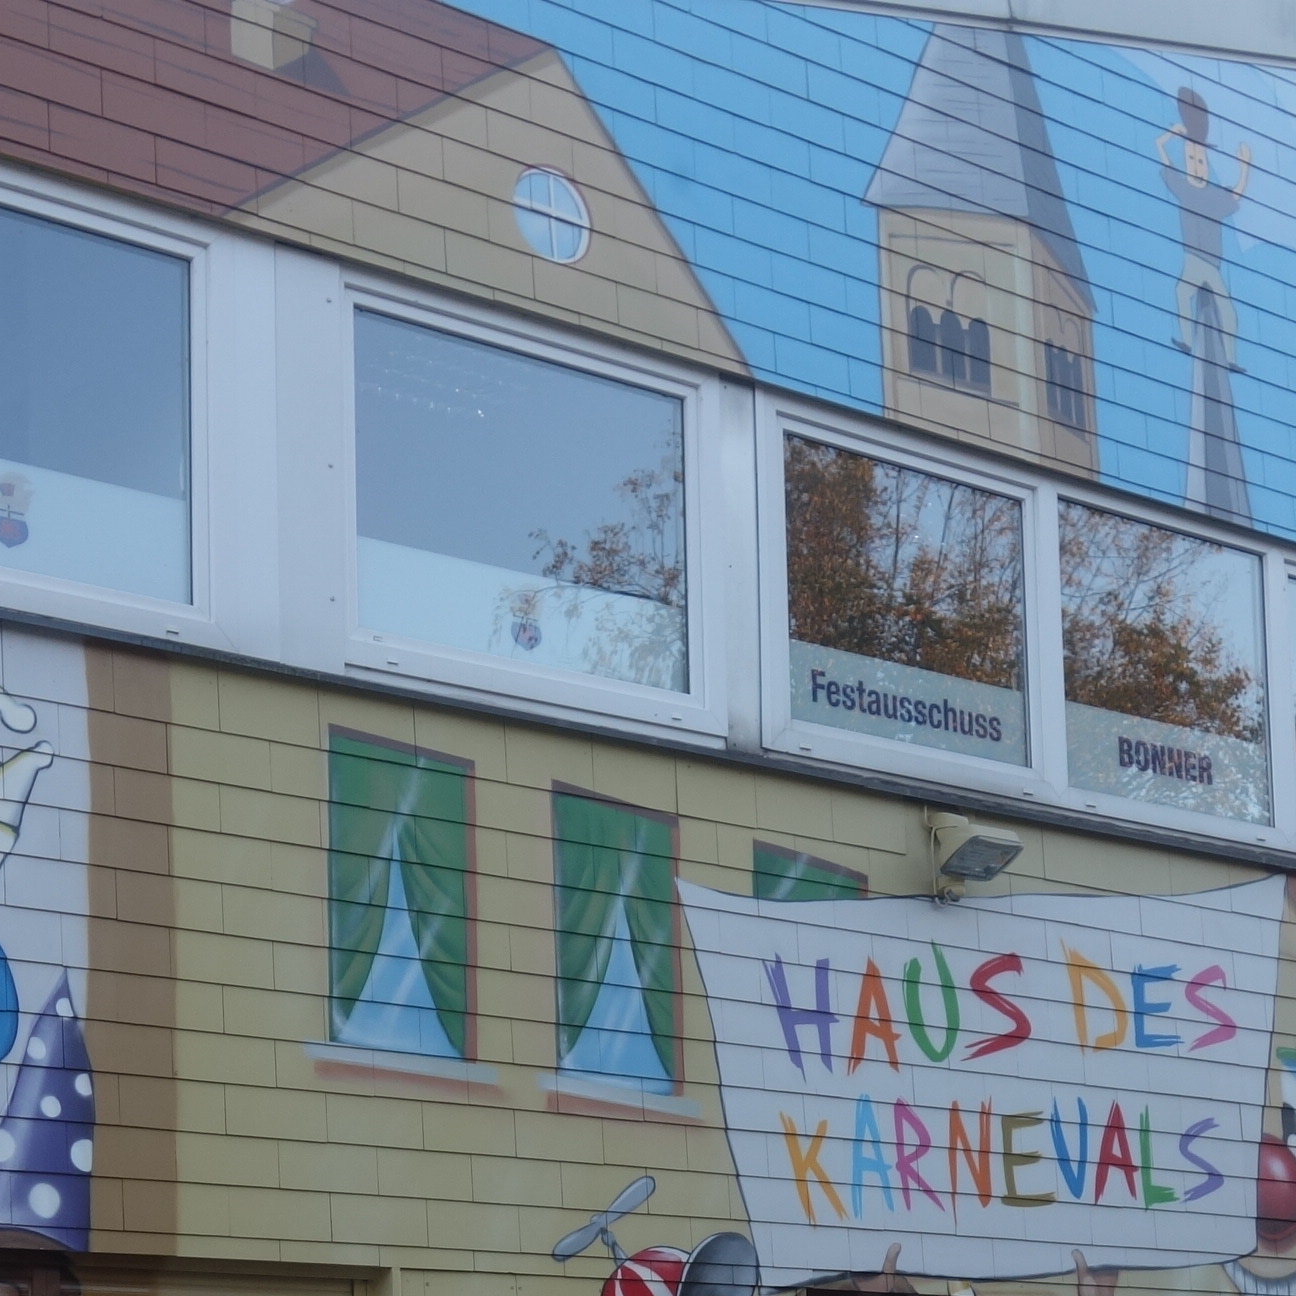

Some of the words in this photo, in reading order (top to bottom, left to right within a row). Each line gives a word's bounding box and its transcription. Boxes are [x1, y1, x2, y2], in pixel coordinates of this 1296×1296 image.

[810, 668, 1003, 742] Festausschuss
[1117, 735, 1214, 786] BONNER
[762, 939, 1033, 1084] HAUS
[1060, 937, 1238, 1054] DES
[779, 1094, 1226, 1229] KARNEVALS
